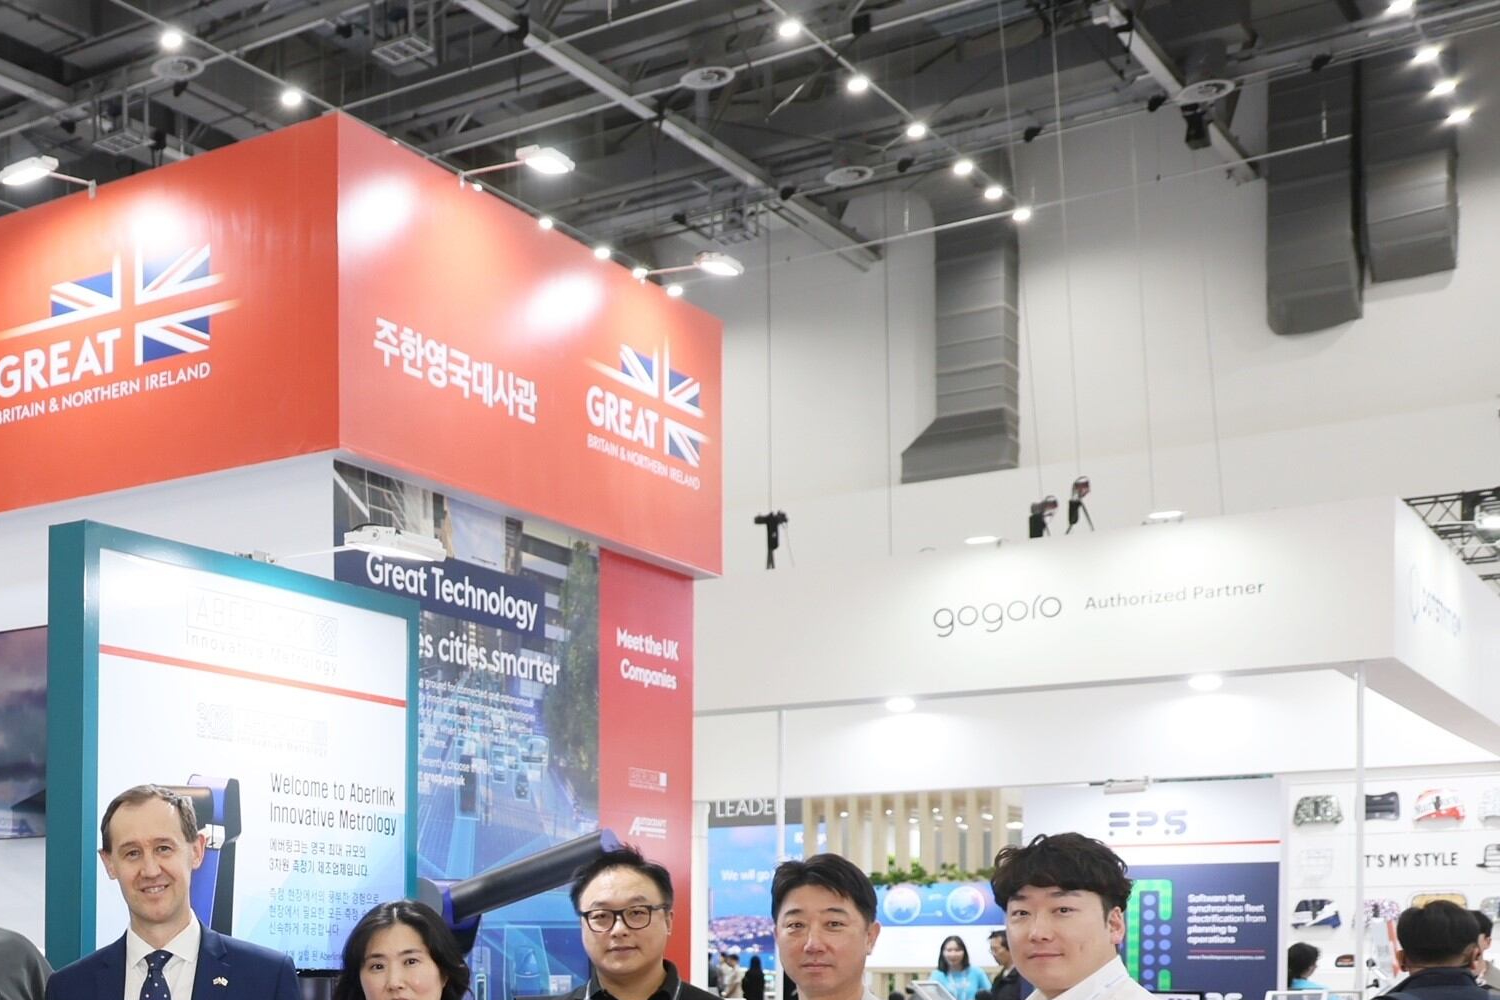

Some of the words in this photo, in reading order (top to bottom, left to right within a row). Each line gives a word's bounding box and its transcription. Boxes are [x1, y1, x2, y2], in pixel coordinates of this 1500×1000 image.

[373, 316, 538, 424] 주한영국대사관
[49, 398, 59, 413] &
[61, 379, 140, 410] NORTHERN
[145, 362, 211, 391] IRELAND
[586, 385, 658, 449] GREAT
[587, 433, 618, 459] BRITAIN
[619, 442, 626, 460] &
[626, 450, 669, 481] NORTHERN
[669, 463, 700, 491] IRELAND
[366, 553, 427, 596] Great
[431, 567, 538, 631] Technology
[933, 594, 1062, 637] gogoro
[1084, 587, 1186, 611] Authorized
[1193, 582, 1265, 600] Partner
[438, 631, 487, 669] cities
[492, 650, 560, 685] smarter
[616, 627, 644, 652] Meet
[644, 633, 662, 656] the
[663, 638, 679, 661] UK
[620, 658, 677, 690] Companies
[270, 772, 328, 799] Welcome
[333, 782, 345, 800] to
[350, 783, 395, 807] Aberlink
[270, 802, 334, 828] Innovative
[340, 809, 396, 836] Metrology
[716, 799, 779, 817] LEADE
[1109, 810, 1188, 837] FPS
[311, 841, 326, 855] 영국
[1390, 854, 1409, 867] MY
[1414, 852, 1458, 867] STYLE
[293, 860, 315, 874] 측정기
[721, 869, 738, 881] We
[740, 868, 755, 880] will
[756, 870, 770, 882] go
[1187, 894, 1226, 903] Software
[1228, 894, 1245, 902] that
[1187, 904, 1243, 914] synchronises
[1244, 903, 1264, 912] fleet
[1187, 914, 1244, 924] electrification
[1245, 914, 1267, 923] from
[1187, 925, 1226, 935] planning
[1228, 925, 1238, 933] to
[1187, 935, 1236, 945] operations
